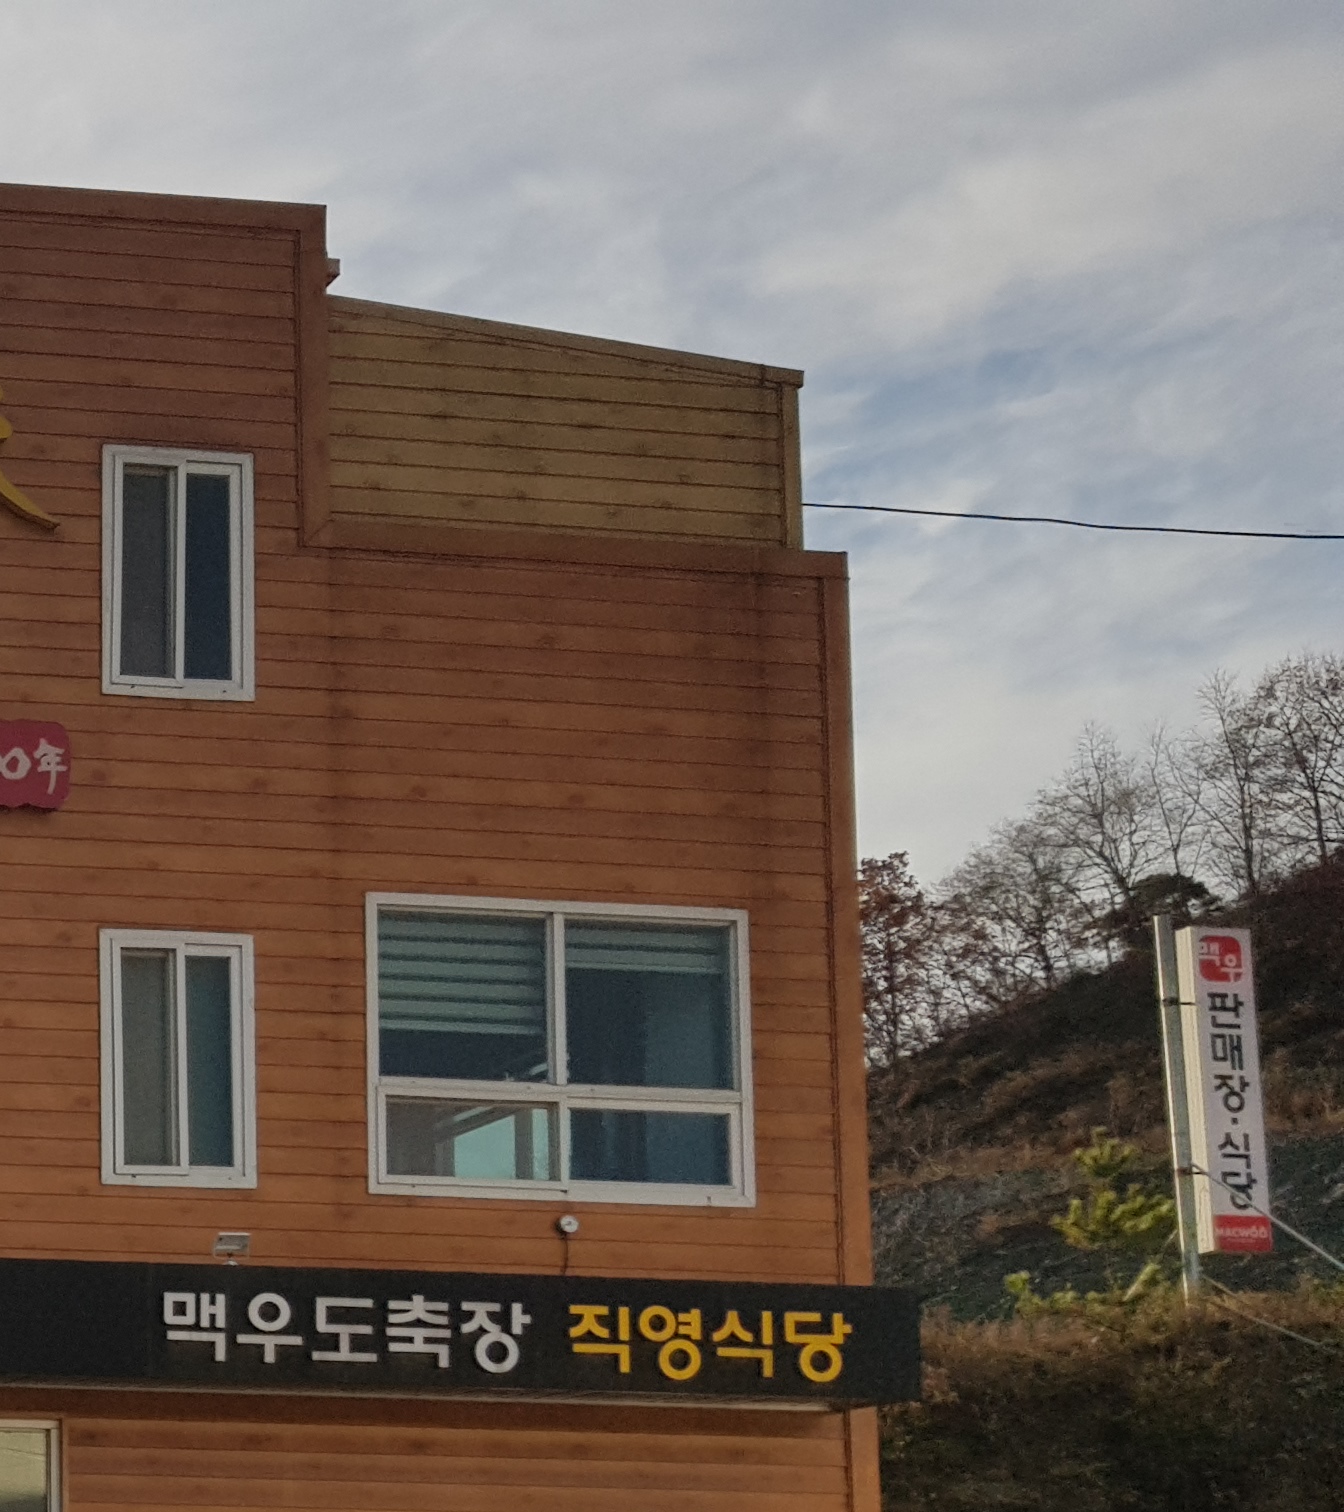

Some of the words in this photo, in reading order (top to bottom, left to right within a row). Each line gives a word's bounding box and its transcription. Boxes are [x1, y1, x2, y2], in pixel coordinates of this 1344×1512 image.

[1199, 941, 1245, 982] 맥우
[162, 1291, 532, 1374] 맥우도축장
[567, 1303, 853, 1384] 직영식당
